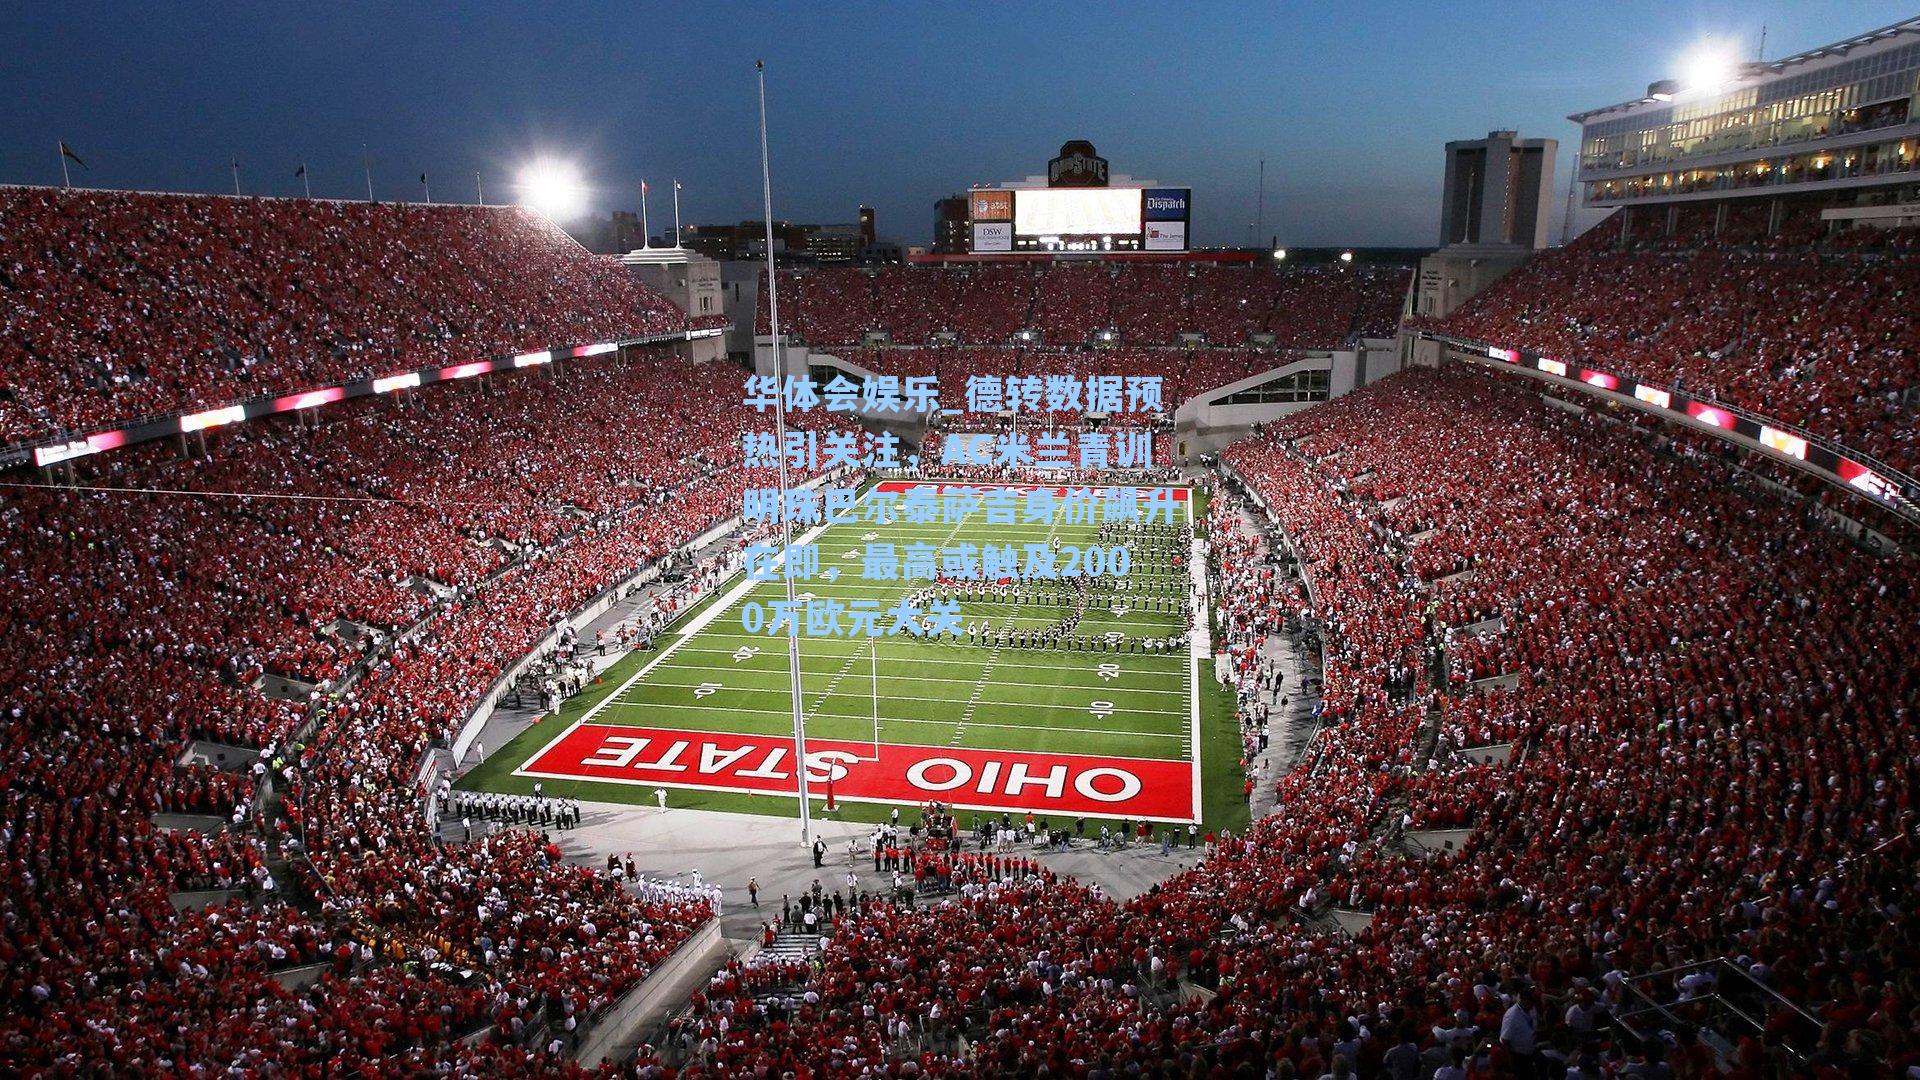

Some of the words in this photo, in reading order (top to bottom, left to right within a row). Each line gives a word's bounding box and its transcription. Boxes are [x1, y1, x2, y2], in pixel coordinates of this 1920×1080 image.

[1146, 197, 1185, 211] Dispatch
[983, 228, 1002, 236] DSW
[1098, 663, 1120, 679] 20
[1089, 701, 1114, 715] 10
[581, 735, 859, 785] STATE
[906, 757, 1142, 803] OHIO
